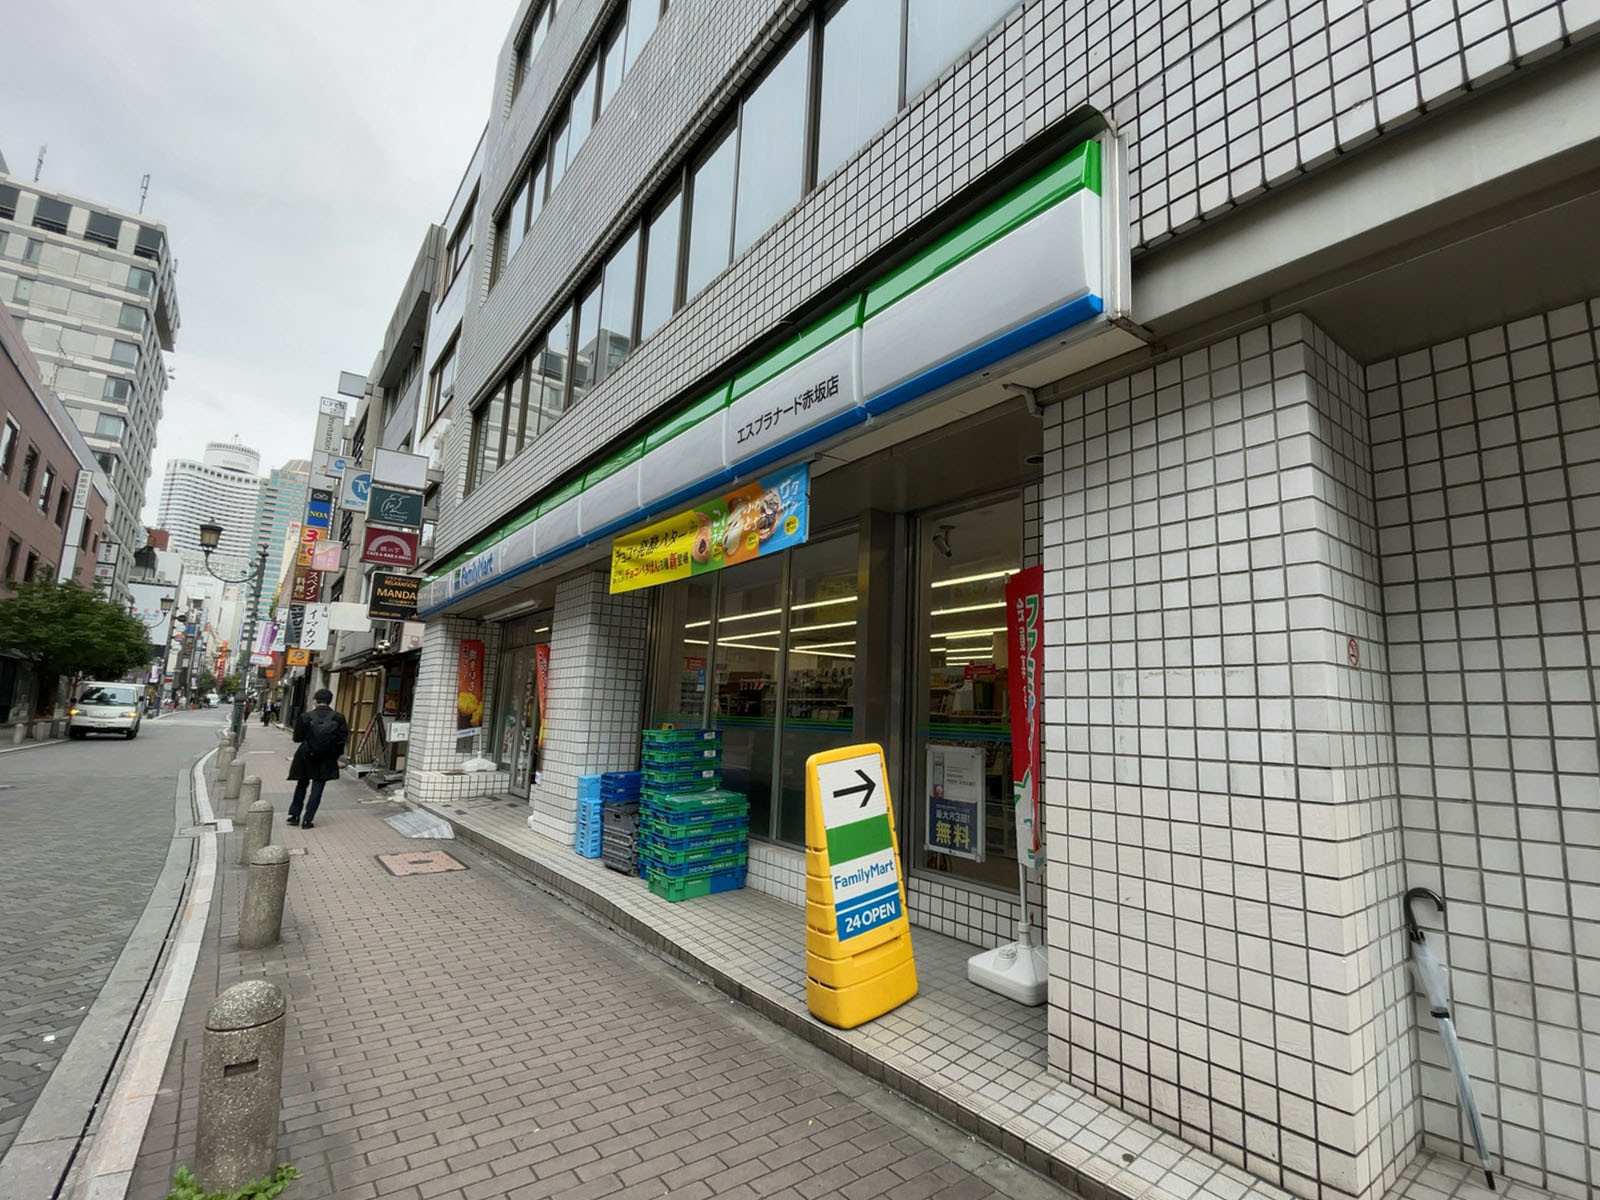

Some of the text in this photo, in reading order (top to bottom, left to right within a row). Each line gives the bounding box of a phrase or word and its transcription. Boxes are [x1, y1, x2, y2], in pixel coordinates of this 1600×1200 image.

[737, 374, 839, 444] エスプラナード赤坂店
[309, 510, 328, 519] NOA
[303, 609, 318, 647] イマカツ
[936, 821, 970, 849] 無料
[834, 859, 894, 890] FamilyMart
